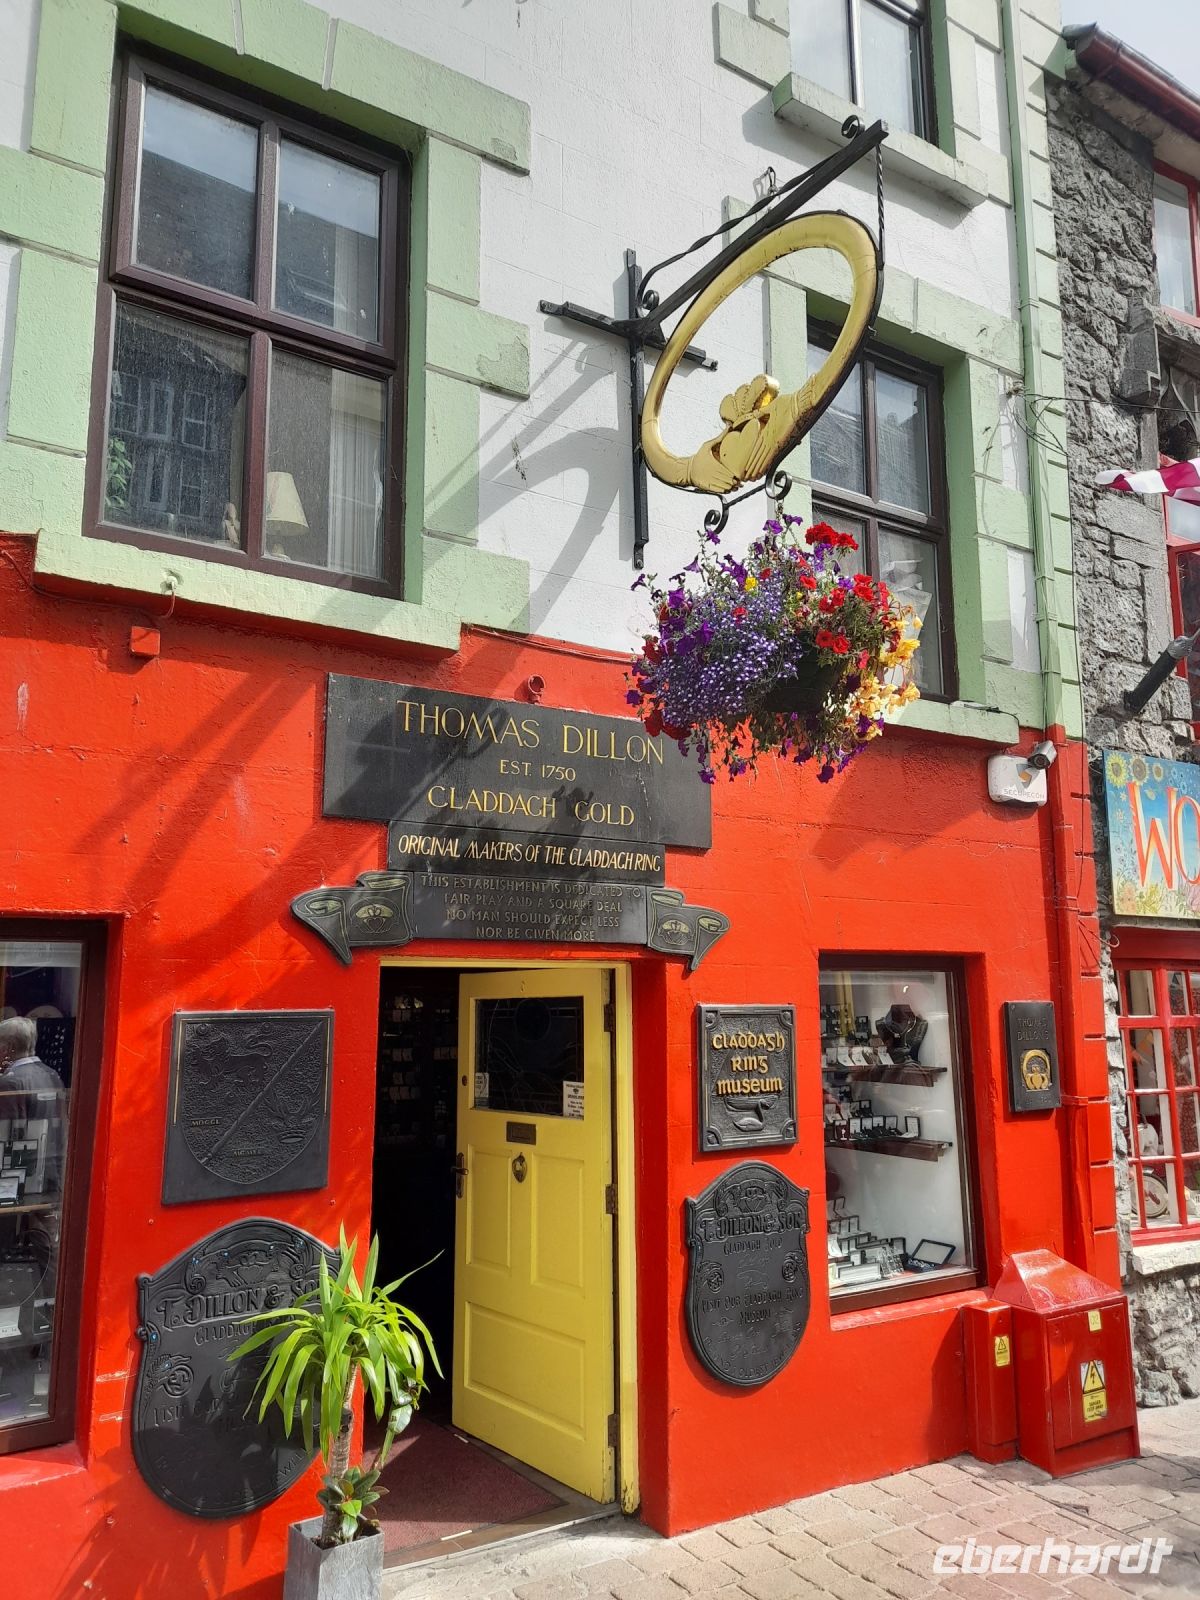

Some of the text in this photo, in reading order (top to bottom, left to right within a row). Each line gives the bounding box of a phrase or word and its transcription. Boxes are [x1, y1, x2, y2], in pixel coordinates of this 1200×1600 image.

[396, 700, 664, 765] THOMAS DILLON
[500, 759, 576, 782] EST. 1750
[427, 785, 635, 826] CLADDAGH GOLD
[398, 834, 661, 872] ORIGINAL MAKERS OF THE CLADDAGH RING
[421, 875, 449, 887] THIS
[454, 877, 547, 893] ESTABLISHMENT
[551, 882, 560, 893] IS
[565, 883, 623, 897] DEDICATED
[444, 893, 471, 905] FAIR
[475, 894, 503, 906] PLAY
[507, 896, 532, 907] AND
[550, 899, 592, 910] SQUARE
[596, 901, 622, 912] DEAL
[446, 909, 619, 927] NO MAN SHOULD EXPECT LESS
[476, 927, 595, 941] NOR BE GIVEN MORE
[718, 1214, 763, 1239] DILLON
[779, 1211, 801, 1234] SON
[183, 1288, 260, 1325] DILLON
[265, 1284, 285, 1309] &
